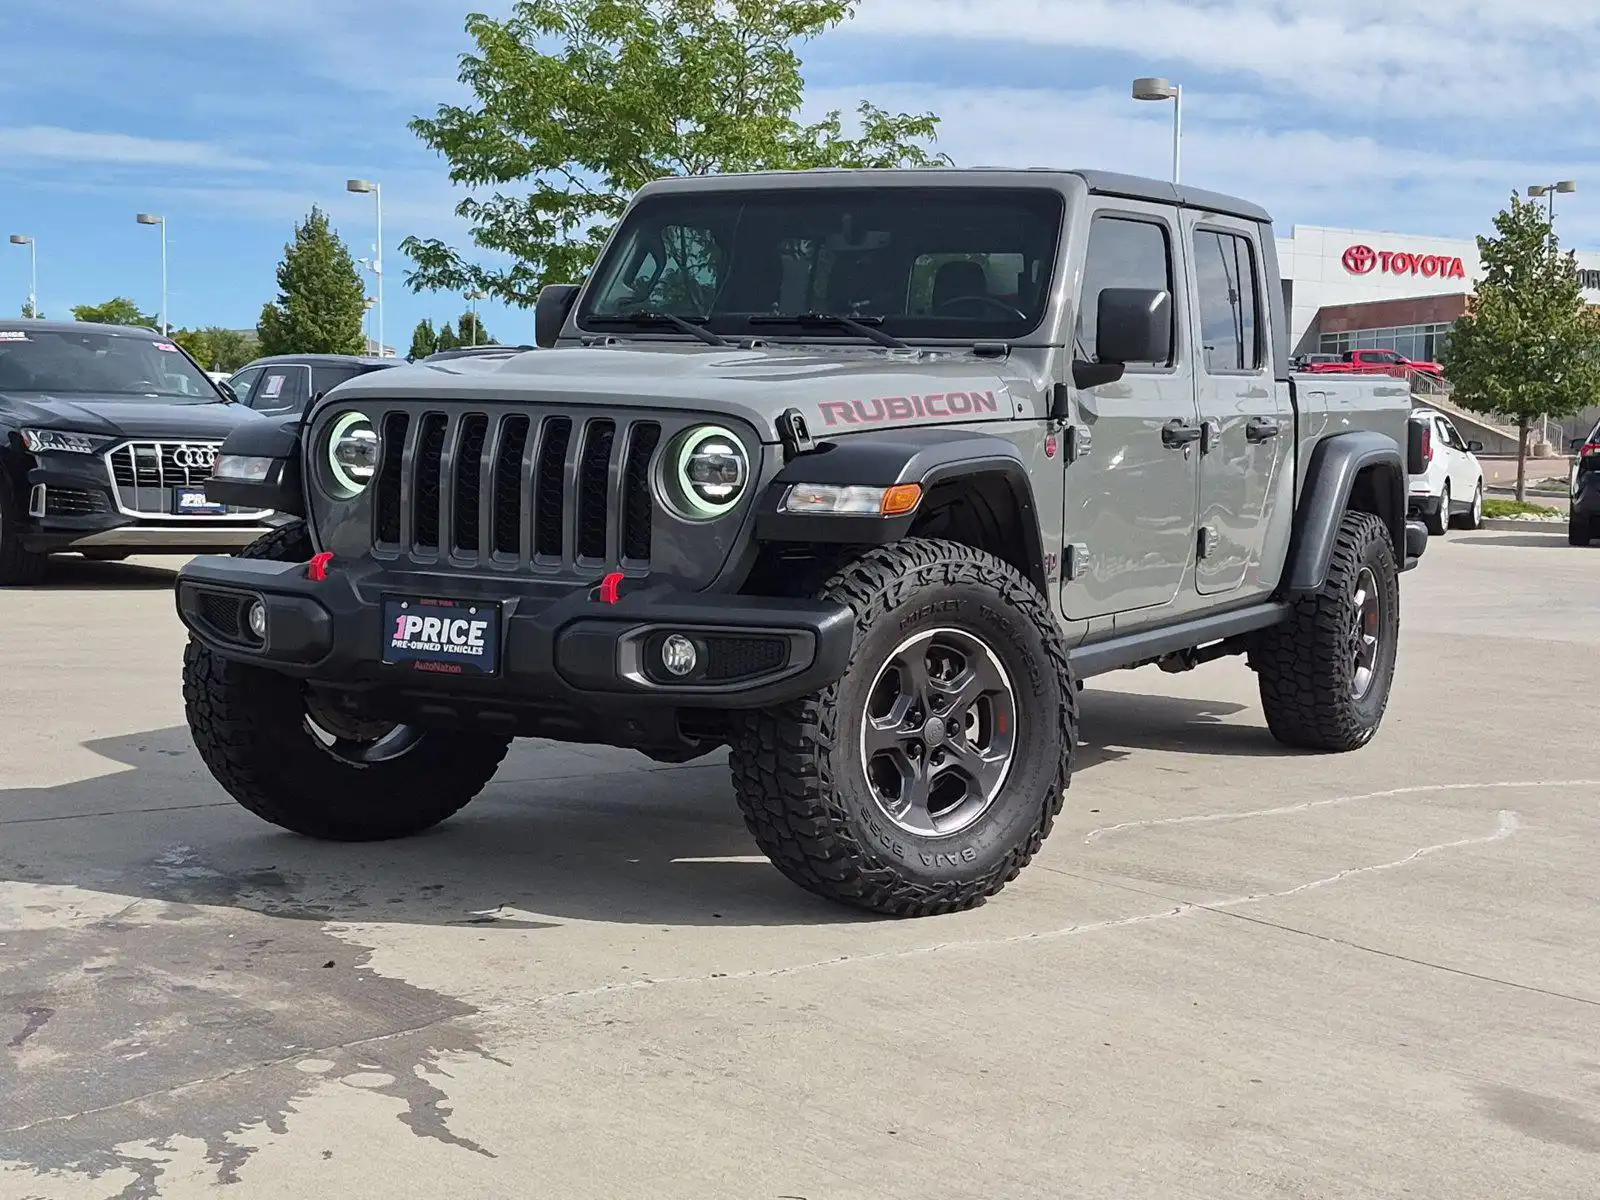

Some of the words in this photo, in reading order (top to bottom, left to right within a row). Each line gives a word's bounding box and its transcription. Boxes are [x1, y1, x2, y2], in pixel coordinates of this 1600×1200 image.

[1379, 251, 1465, 279] TOYOTA
[817, 390, 998, 426] RUBICON
[393, 615, 488, 646] 1PRICE
[391, 639, 441, 652] PRE-OWNED
[443, 644, 483, 655] VEHICLES
[414, 661, 461, 673] AutoNation
[919, 847, 977, 867] BAJA
